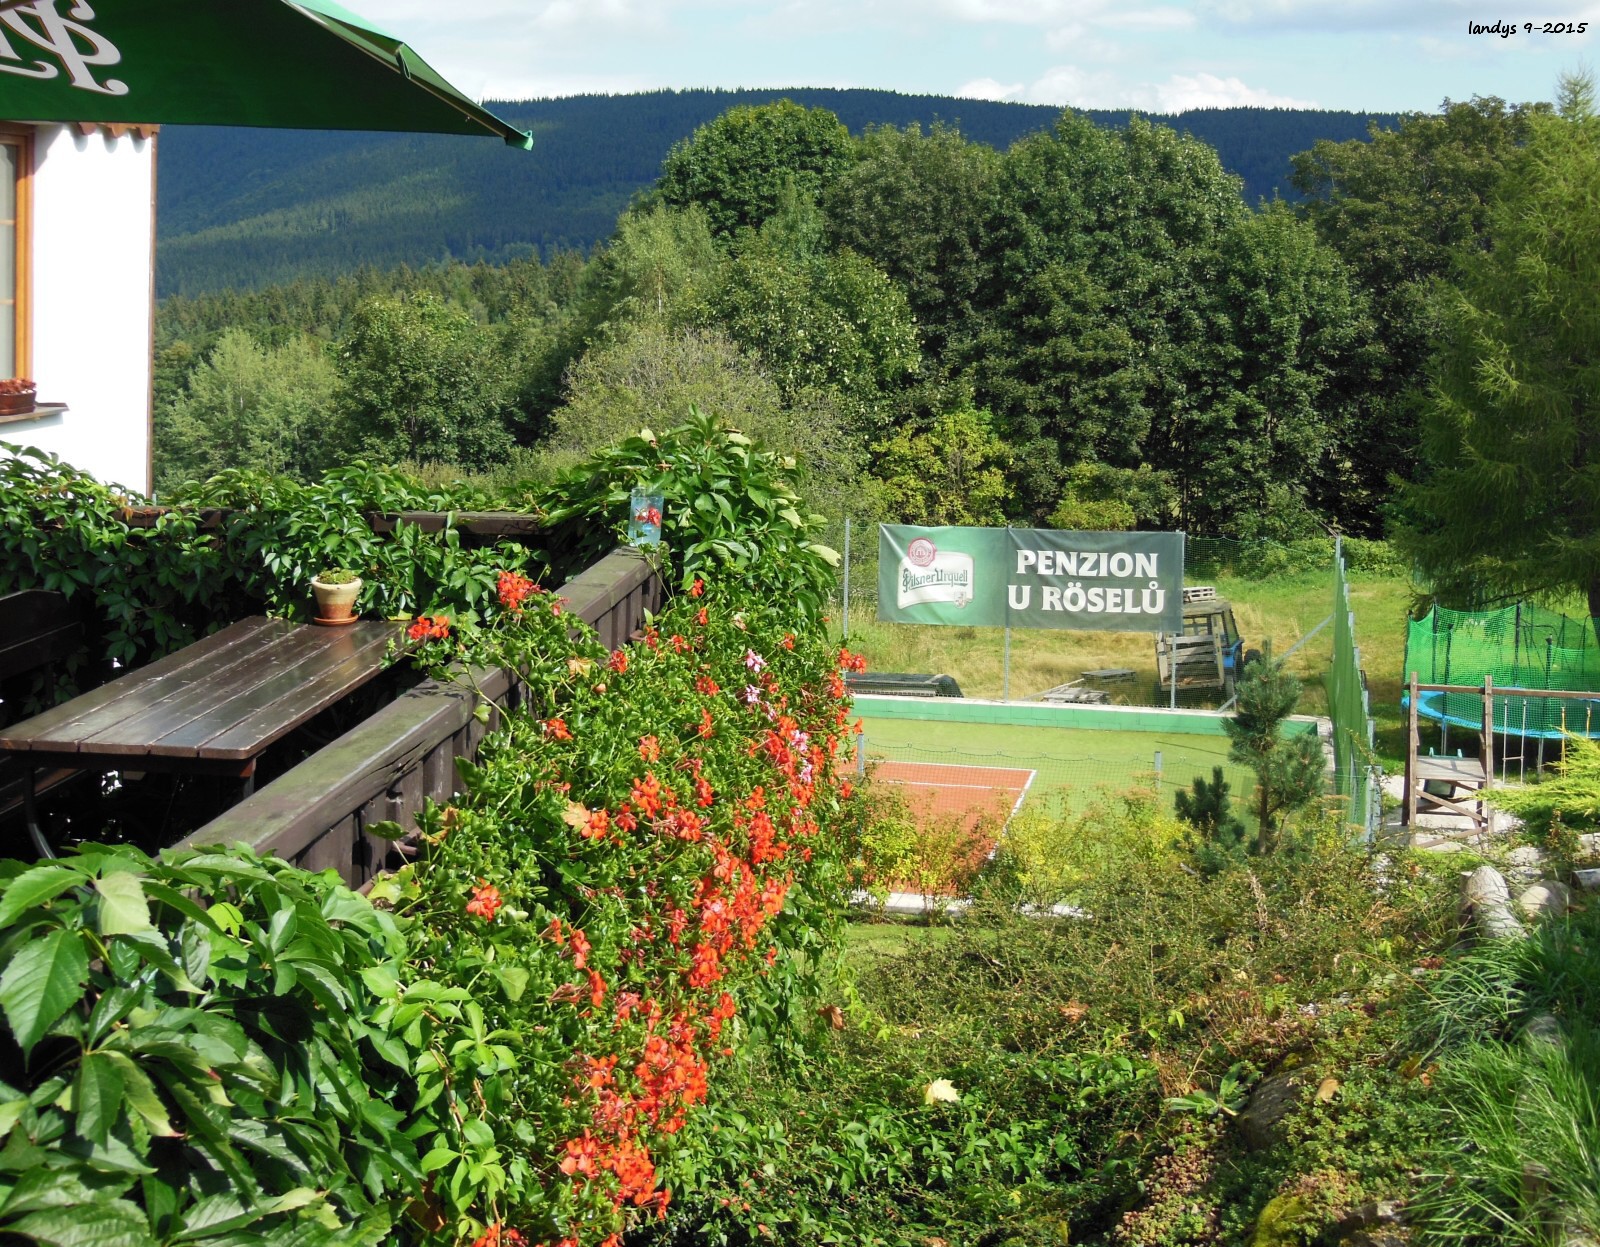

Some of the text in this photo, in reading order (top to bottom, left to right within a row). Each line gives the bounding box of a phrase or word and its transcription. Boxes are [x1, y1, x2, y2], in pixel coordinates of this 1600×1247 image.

[1016, 549, 1159, 578] PENZION
[902, 568, 968, 593] Pilsner Urquell
[1007, 581, 1166, 614] U RÖSELŮ
